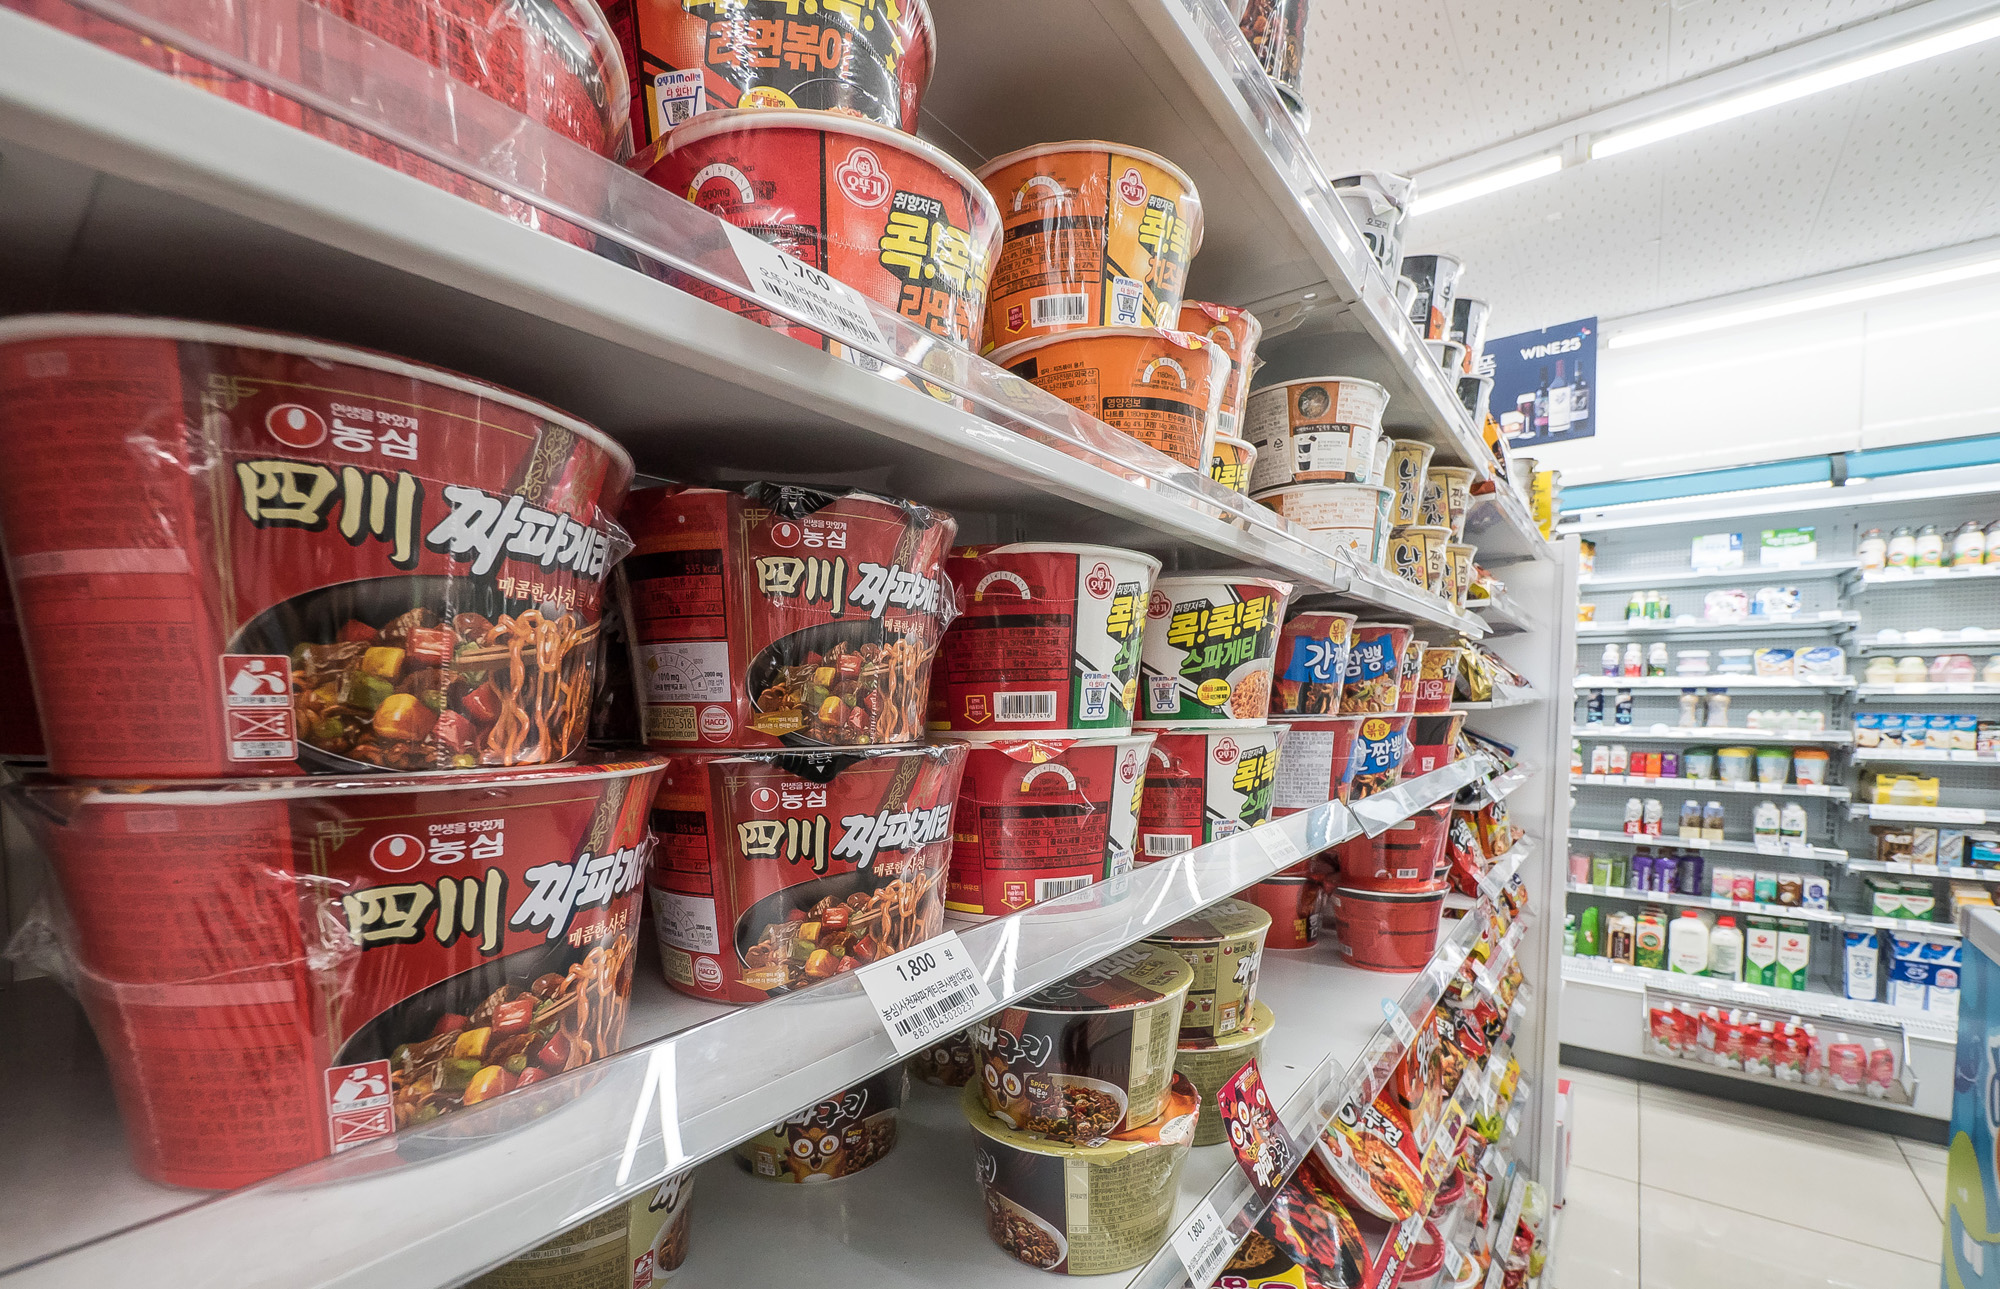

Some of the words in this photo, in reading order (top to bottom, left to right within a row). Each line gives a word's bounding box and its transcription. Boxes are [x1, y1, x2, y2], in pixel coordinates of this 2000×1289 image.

[666, 87, 674, 98] 다
[847, 176, 882, 198] 오뚜기
[1123, 184, 1144, 199] 오뚜기
[893, 192, 942, 218] 취향저격
[777, 254, 830, 291] 1,700
[1520, 337, 1581, 360] WINE25
[1106, 398, 1141, 408] 영양정보
[374, 408, 419, 431] 맛있게
[330, 418, 419, 461] 농심
[236, 460, 417, 562] 四川
[803, 518, 825, 529] 인생을
[825, 519, 848, 531] 맛있게
[802, 527, 847, 550] 농심
[497, 577, 546, 600] 매콤한
[547, 584, 577, 609] 사천
[755, 555, 845, 614] 四川
[1090, 580, 1111, 592] 오뚜기
[1175, 599, 1207, 614] 취향저격
[1168, 595, 1271, 648] 콕!콕!콕!
[1179, 634, 1257, 676] 스파게티
[704, 718, 727, 726] HACCP
[1367, 723, 1387, 738] 볶음
[1217, 750, 1236, 760] 오뚜기
[780, 781, 802, 791] 인생을
[780, 790, 827, 810] 농심
[427, 821, 467, 837] 인생을
[467, 818, 505, 834] 맛있게
[736, 815, 827, 872] 四川
[832, 801, 952, 869] 짜파게티
[427, 832, 504, 865] 농심
[873, 858, 904, 878] 매콤한
[905, 854, 926, 874] 사천
[343, 866, 503, 951] 四川
[568, 925, 604, 949] 매콤한
[606, 908, 628, 936] 사천
[698, 967, 717, 976] HACCP
[896, 952, 937, 982] 1,800
[943, 948, 955, 961] 원
[881, 967, 975, 1022] 농심)사천짜파게티큰사발(대컵)
[912, 1000, 976, 1040] 8801043020237
[1187, 1218, 1205, 1242] 1,800
